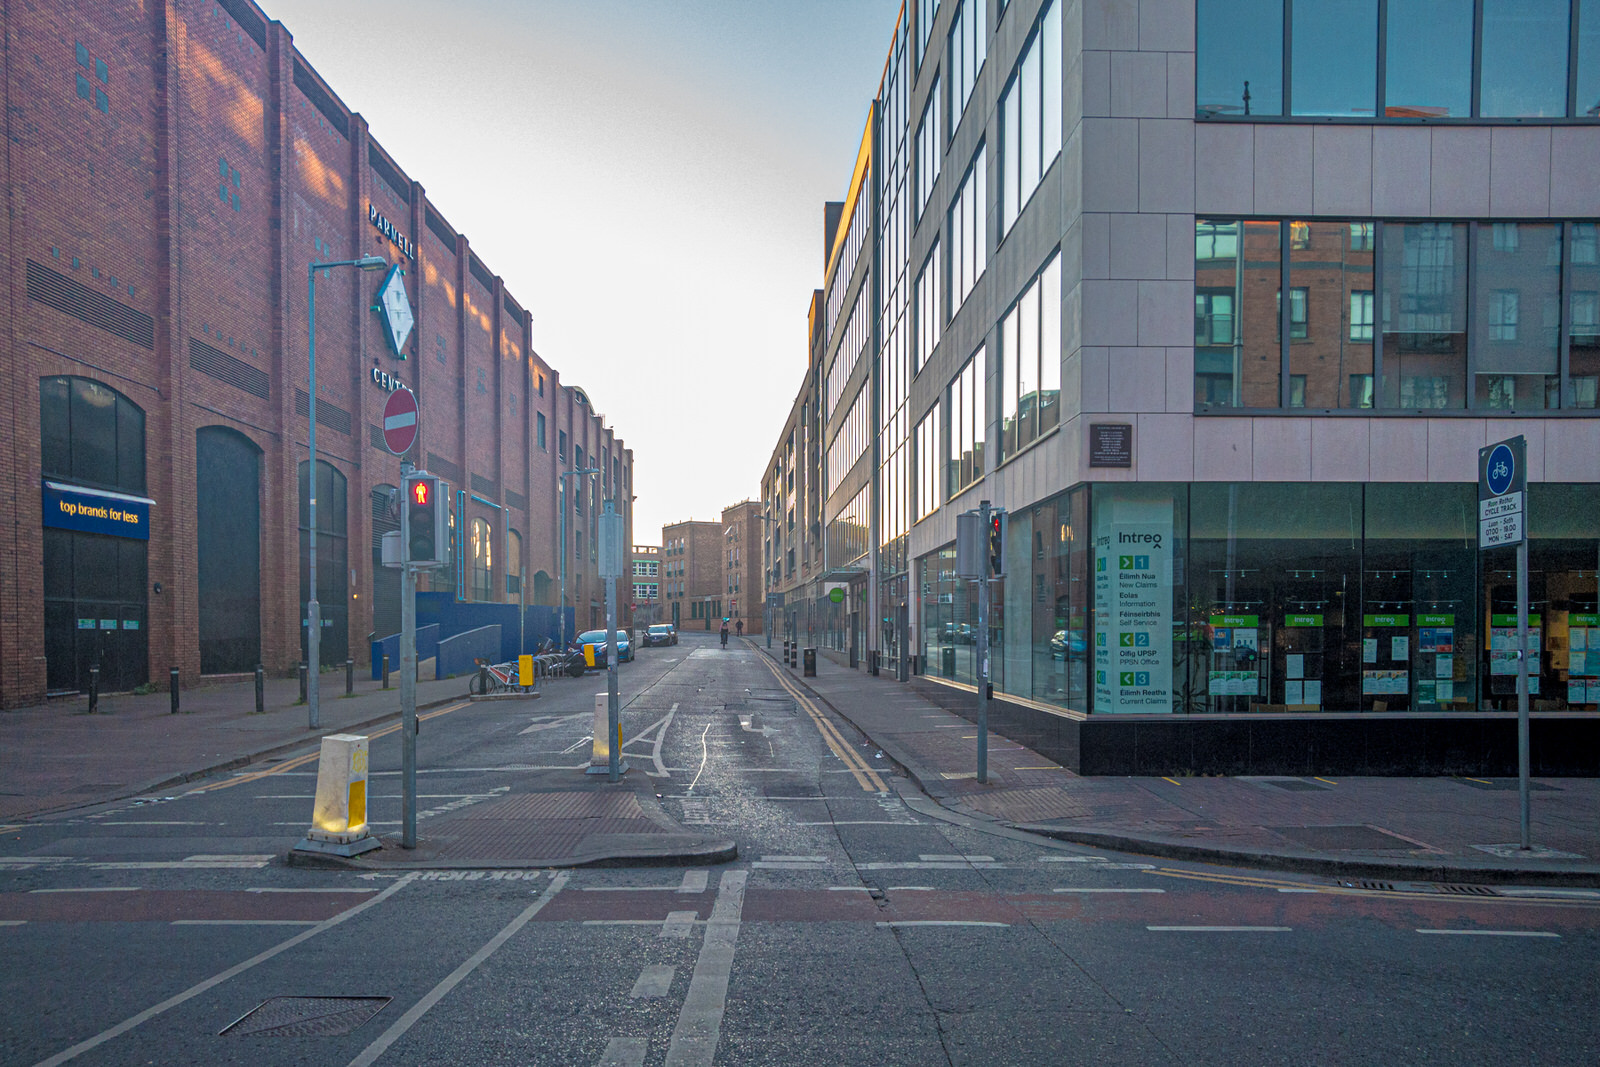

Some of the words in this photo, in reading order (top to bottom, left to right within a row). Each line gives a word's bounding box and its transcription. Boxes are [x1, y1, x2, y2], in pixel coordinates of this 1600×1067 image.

[369, 203, 414, 260] PARNELL
[371, 367, 413, 392] CENT
[60, 500, 77, 516] top
[78, 502, 108, 519] brands
[109, 508, 122, 521] for
[123, 510, 139, 524] less
[1485, 506, 1499, 516] CYCLE
[1501, 503, 1516, 512] TRACK
[1118, 531, 1162, 545] Intreo
[1294, 616, 1315, 624] Intreo
[1374, 616, 1395, 624] Intreo
[1138, 634, 1146, 645] 2
[1138, 673, 1146, 685] 3
[1120, 697, 1144, 705] Current
[1145, 697, 1168, 705] Claims
[486, 870, 558, 881] LOOK
